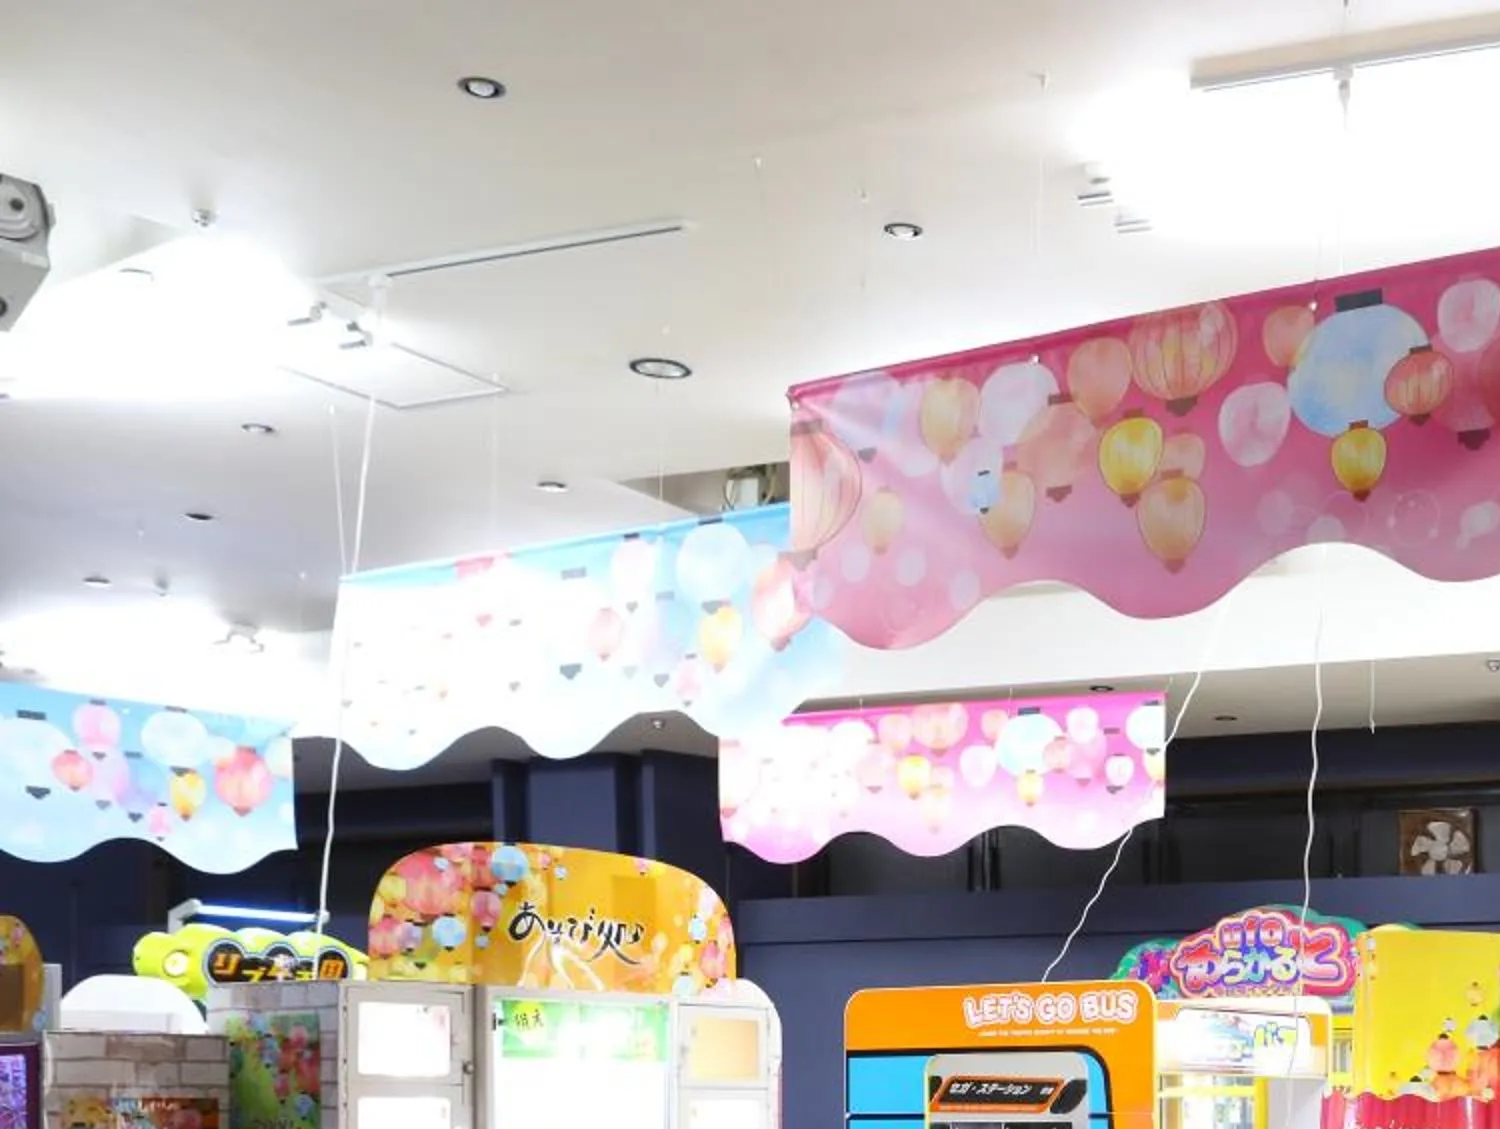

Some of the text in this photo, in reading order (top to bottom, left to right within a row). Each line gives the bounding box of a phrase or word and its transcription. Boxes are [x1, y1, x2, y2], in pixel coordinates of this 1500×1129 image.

[964, 989, 1138, 1027] LET'S GO BUS
